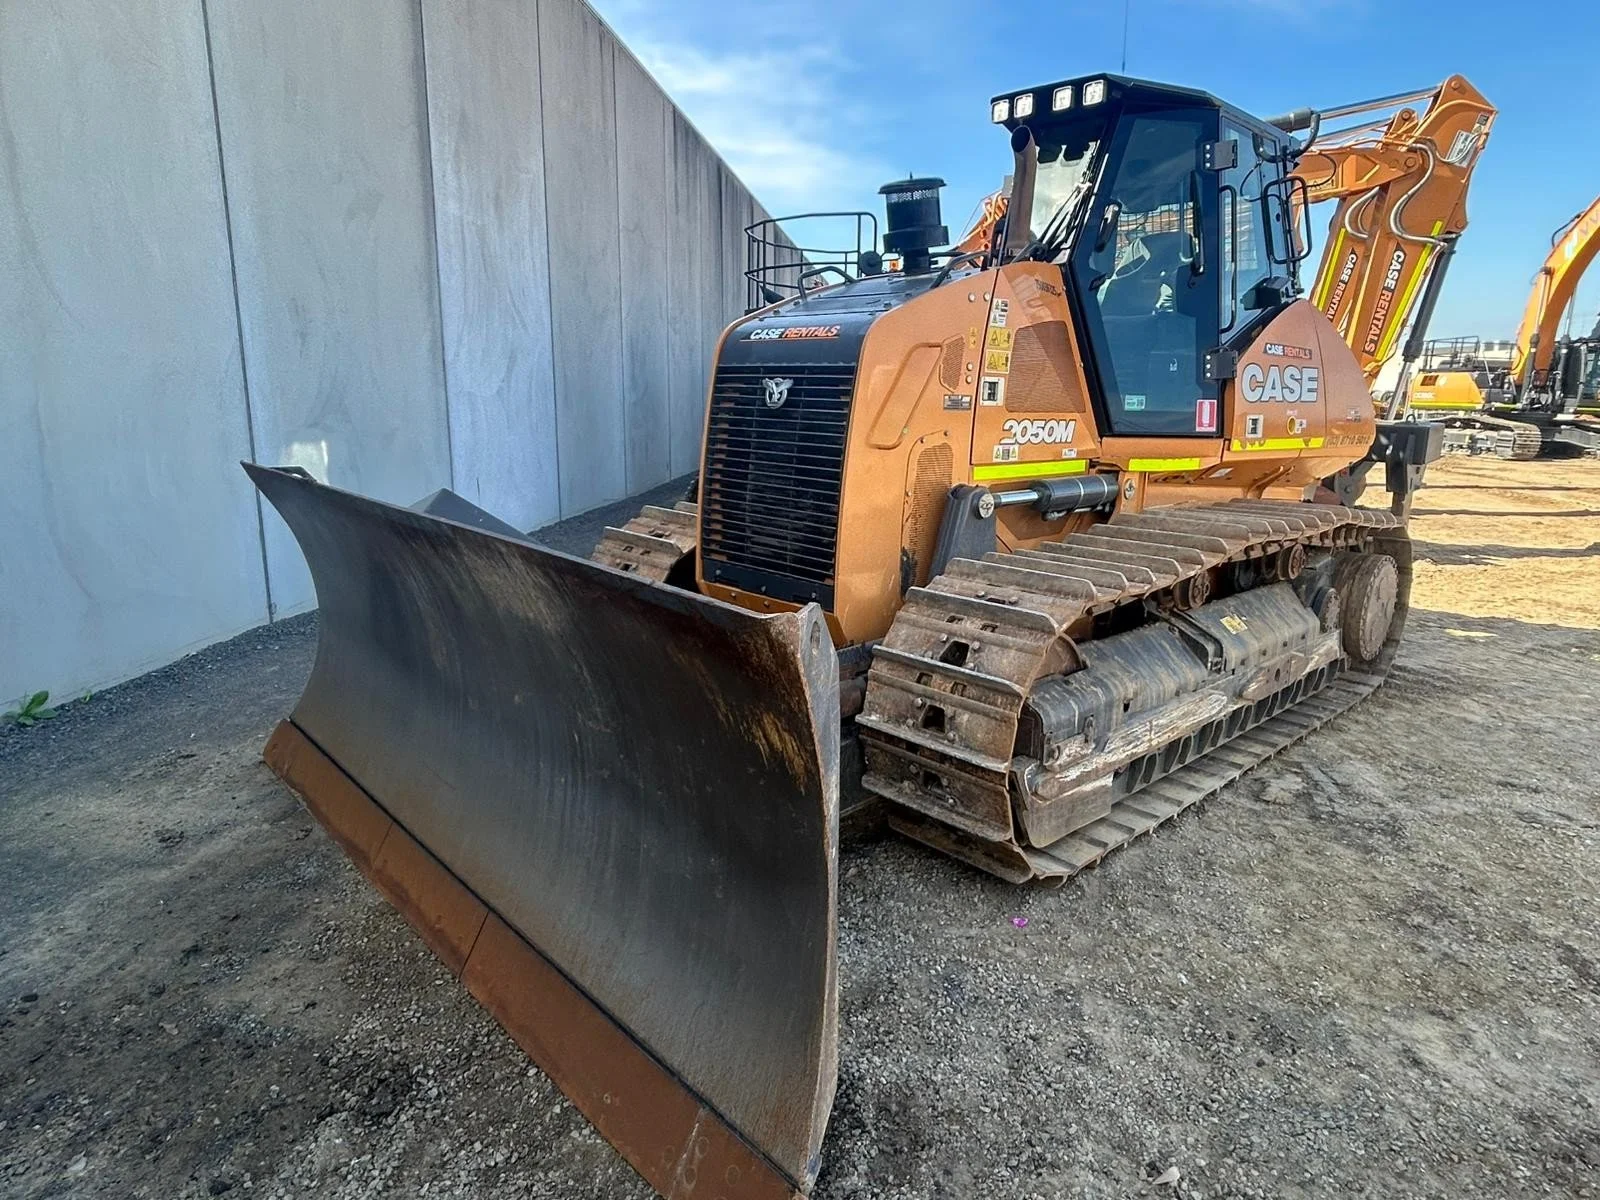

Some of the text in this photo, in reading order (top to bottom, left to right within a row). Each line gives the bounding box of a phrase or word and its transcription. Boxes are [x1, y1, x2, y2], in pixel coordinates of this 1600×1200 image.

[1341, 253, 1357, 284] CASE
[1365, 250, 1405, 353] CASE RENTALS
[750, 325, 840, 340] CASE RENTALS
[1266, 343, 1311, 359] CASE RENTALS
[1241, 362, 1319, 403] CASE
[1000, 418, 1077, 445] 2050M
